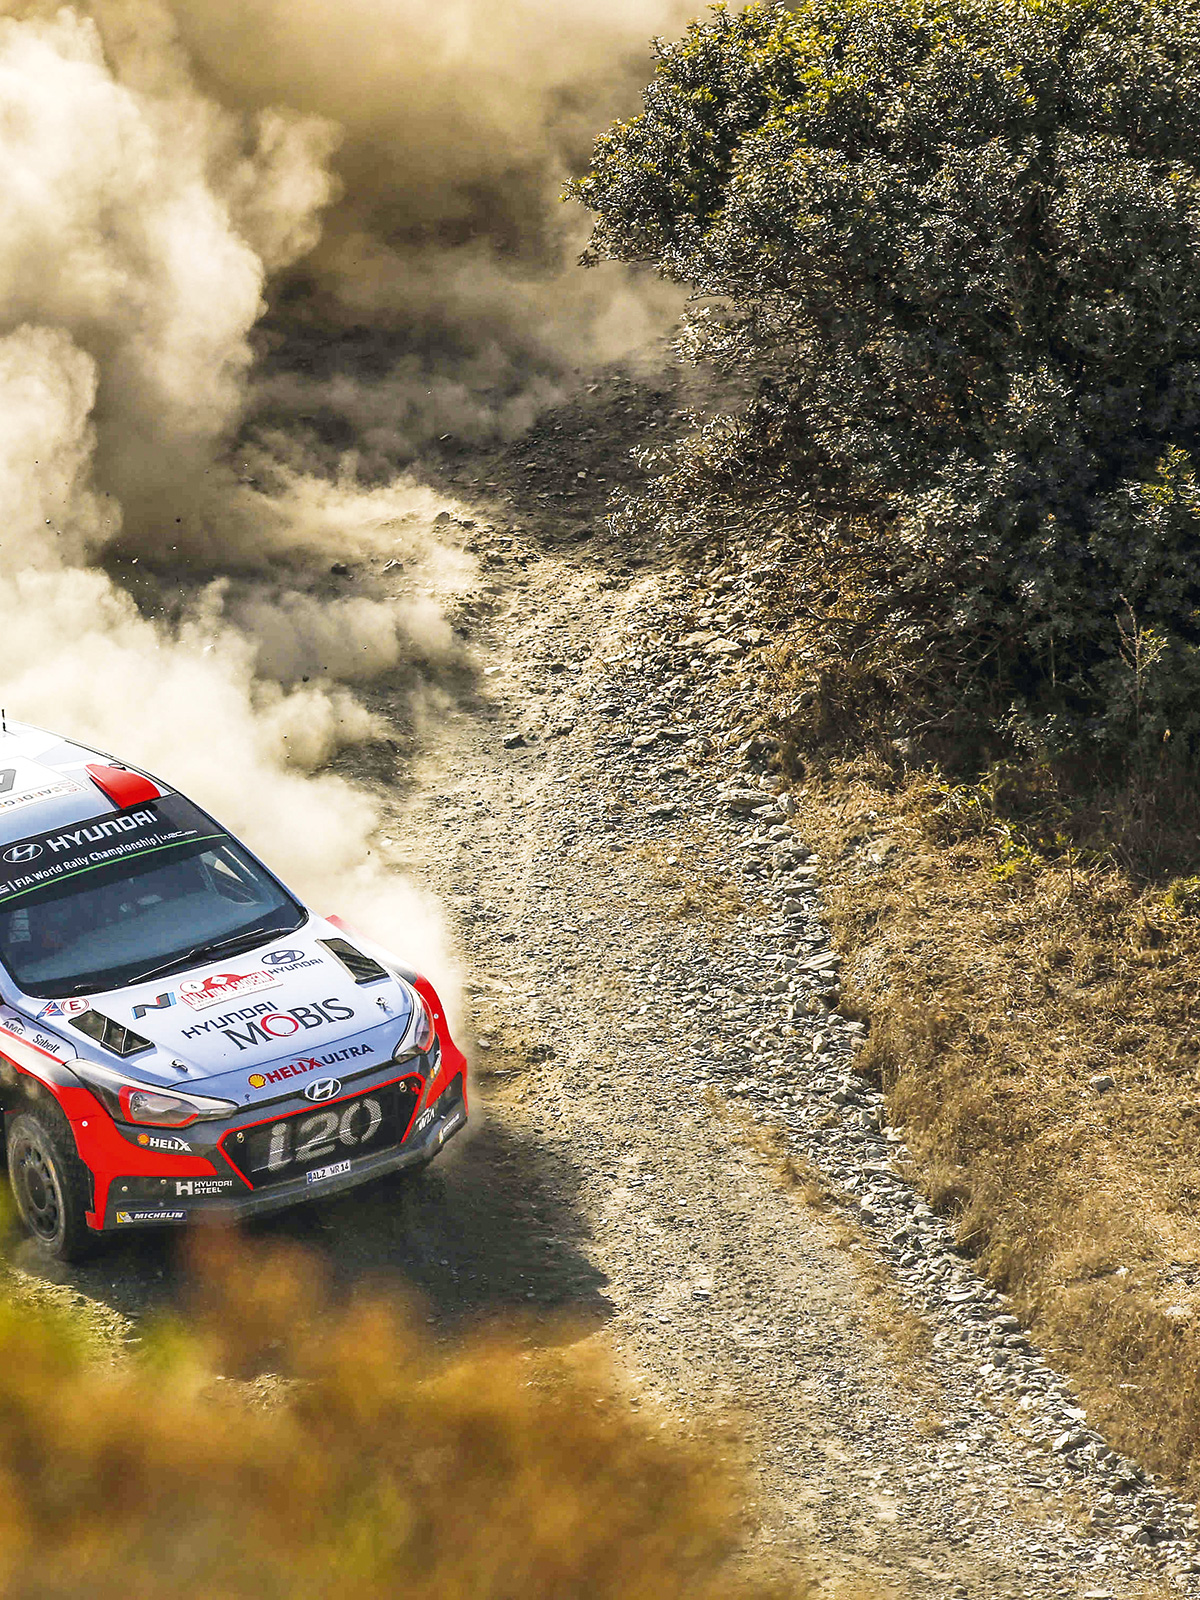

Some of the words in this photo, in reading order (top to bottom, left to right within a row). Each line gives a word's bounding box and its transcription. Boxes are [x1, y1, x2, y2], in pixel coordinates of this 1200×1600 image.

[45, 809, 158, 852] HYUNDAI
[14, 876, 34, 889] FIA
[33, 865, 63, 881] World
[63, 855, 90, 874] Rally
[89, 837, 157, 862] Championship
[268, 958, 324, 976] HYUNDAI
[69, 1000, 81, 1011] E
[2, 1020, 25, 1036] AMG
[181, 1001, 279, 1039] HYUNDAI
[221, 998, 355, 1051] MOBIS
[32, 1034, 60, 1054] Sabelt
[264, 1057, 323, 1084] HELIX
[321, 1043, 374, 1066] ULTRA
[149, 1136, 192, 1152] HELIX
[312, 1169, 327, 1180] ALZ
[194, 1180, 233, 1188] HYUNDAI
[194, 1186, 222, 1195] STEEL
[134, 1212, 184, 1220] MICHELIN
